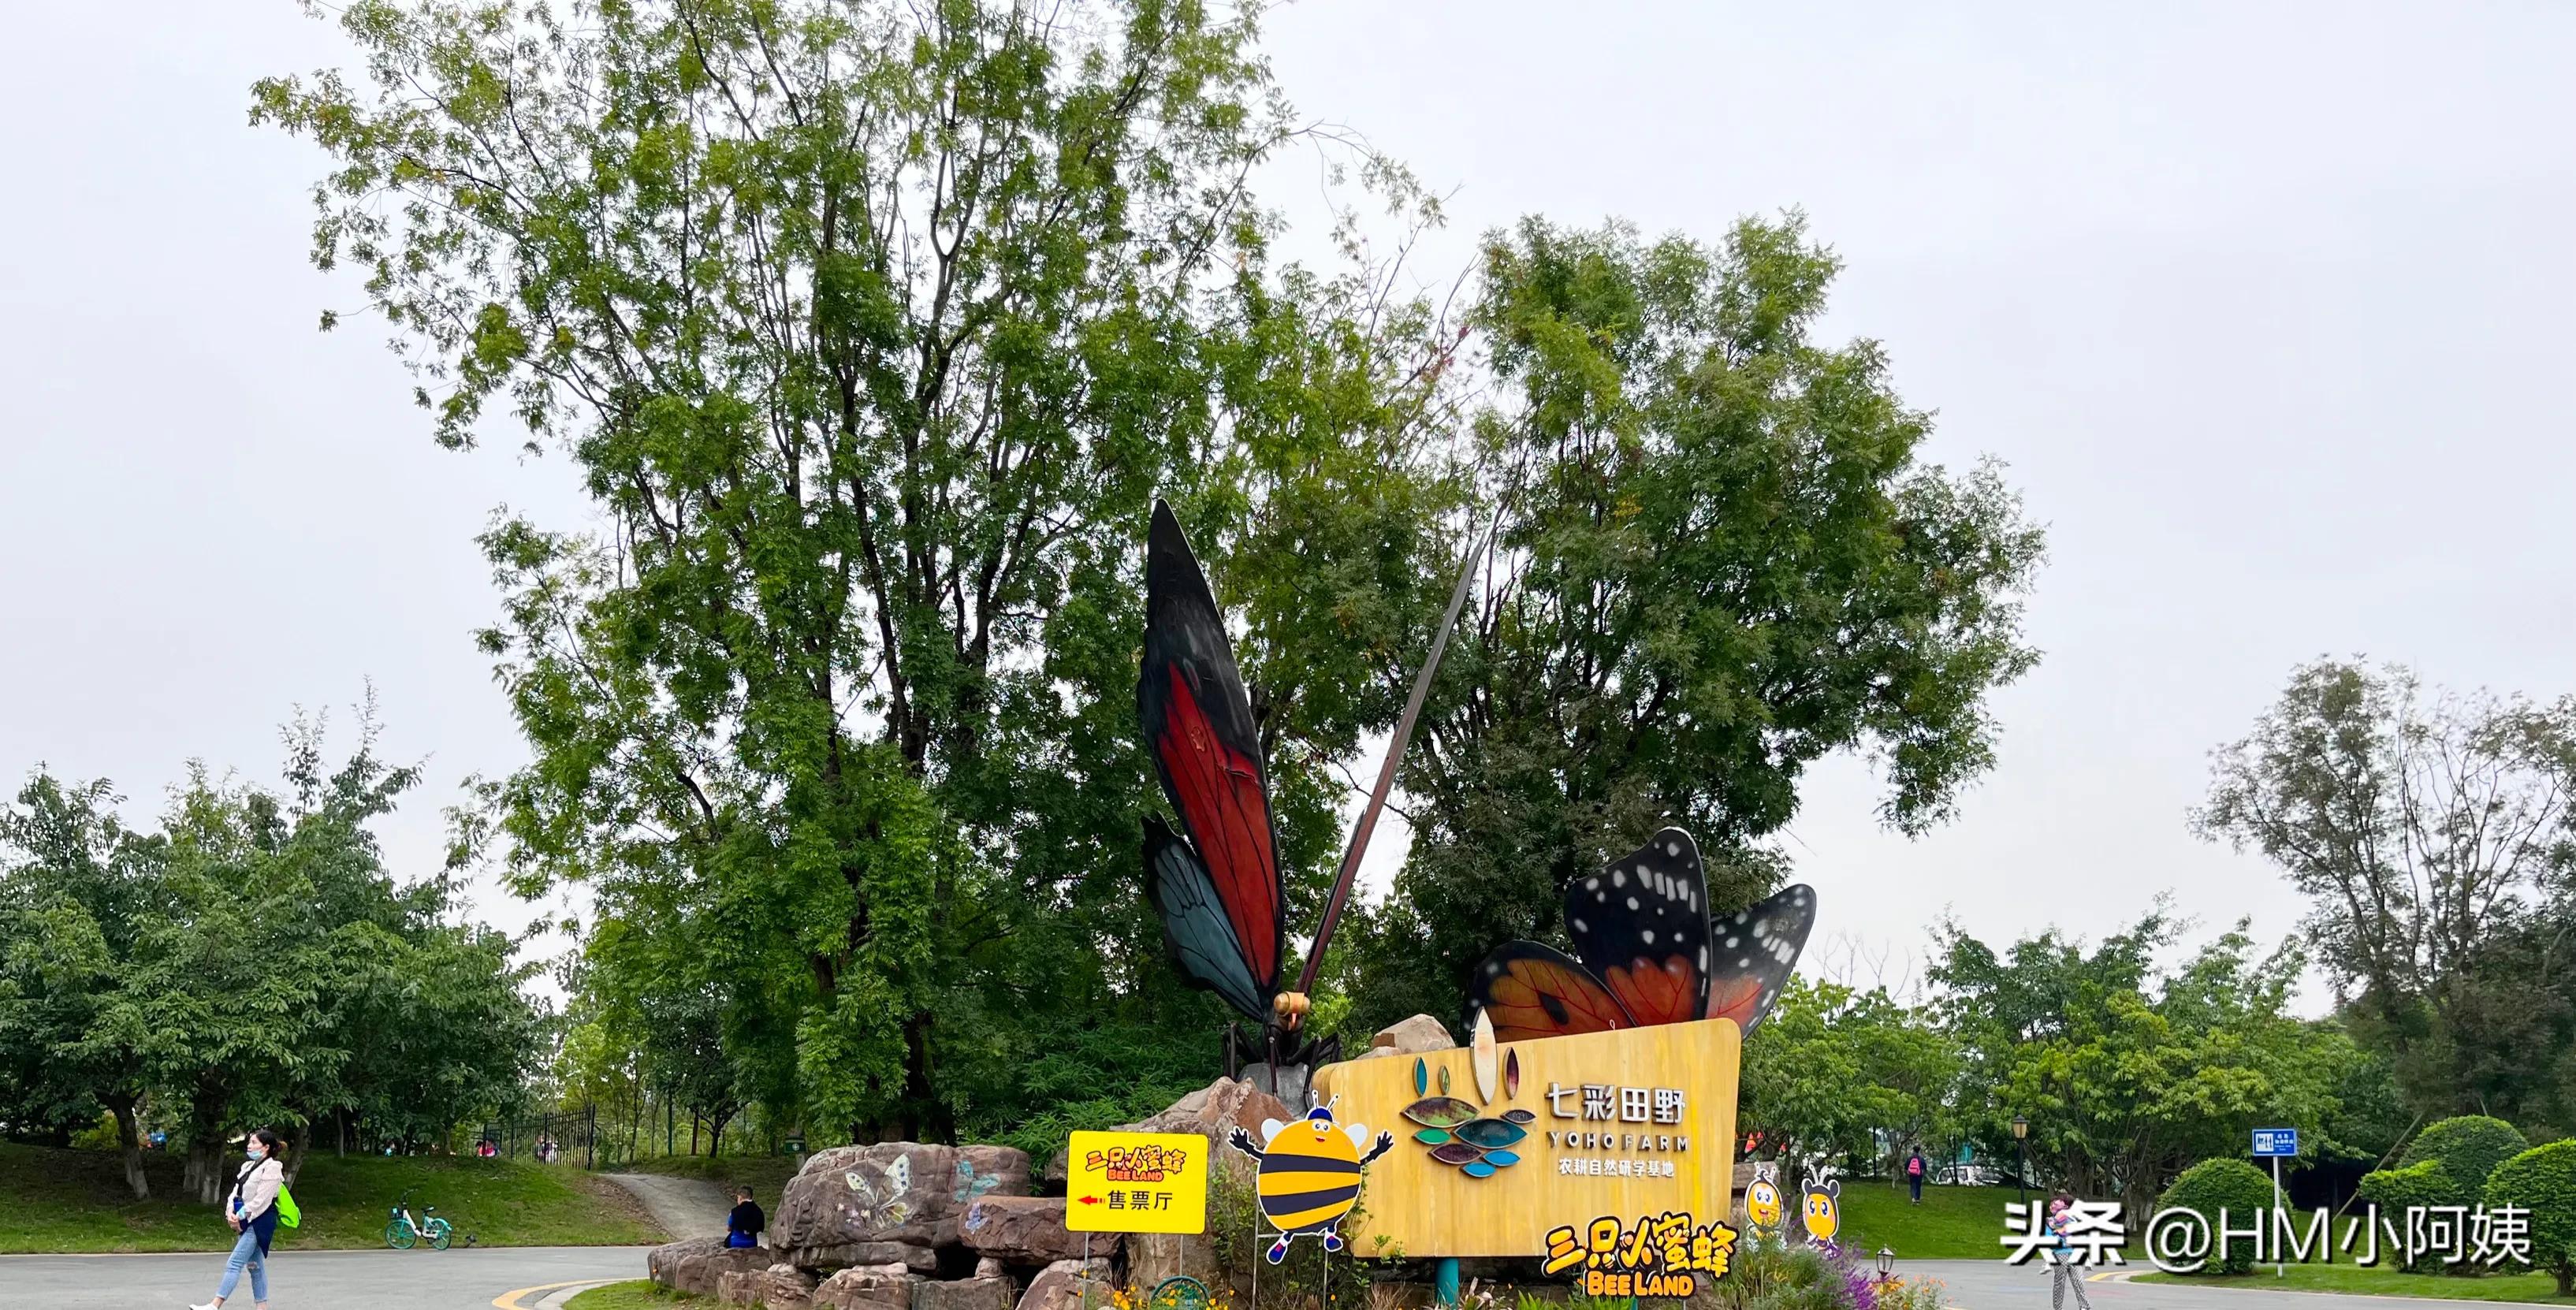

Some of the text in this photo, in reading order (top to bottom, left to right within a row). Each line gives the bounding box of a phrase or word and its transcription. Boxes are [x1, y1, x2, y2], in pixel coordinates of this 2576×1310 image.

[1545, 1082, 1686, 1124] 七彩田野
[1547, 1131, 1688, 1152] YOHO FARM
[1085, 1144, 1186, 1174] 三只小蜜蜂
[1558, 1158, 1675, 1178] 农耕自然研学基地
[1107, 1169, 1164, 1182] BEE LAND
[1107, 1189, 1173, 1211] 售票厅
[1544, 1212, 1738, 1278] 三只小蜜蜂
[1587, 1270, 1695, 1297] BEE LAND
